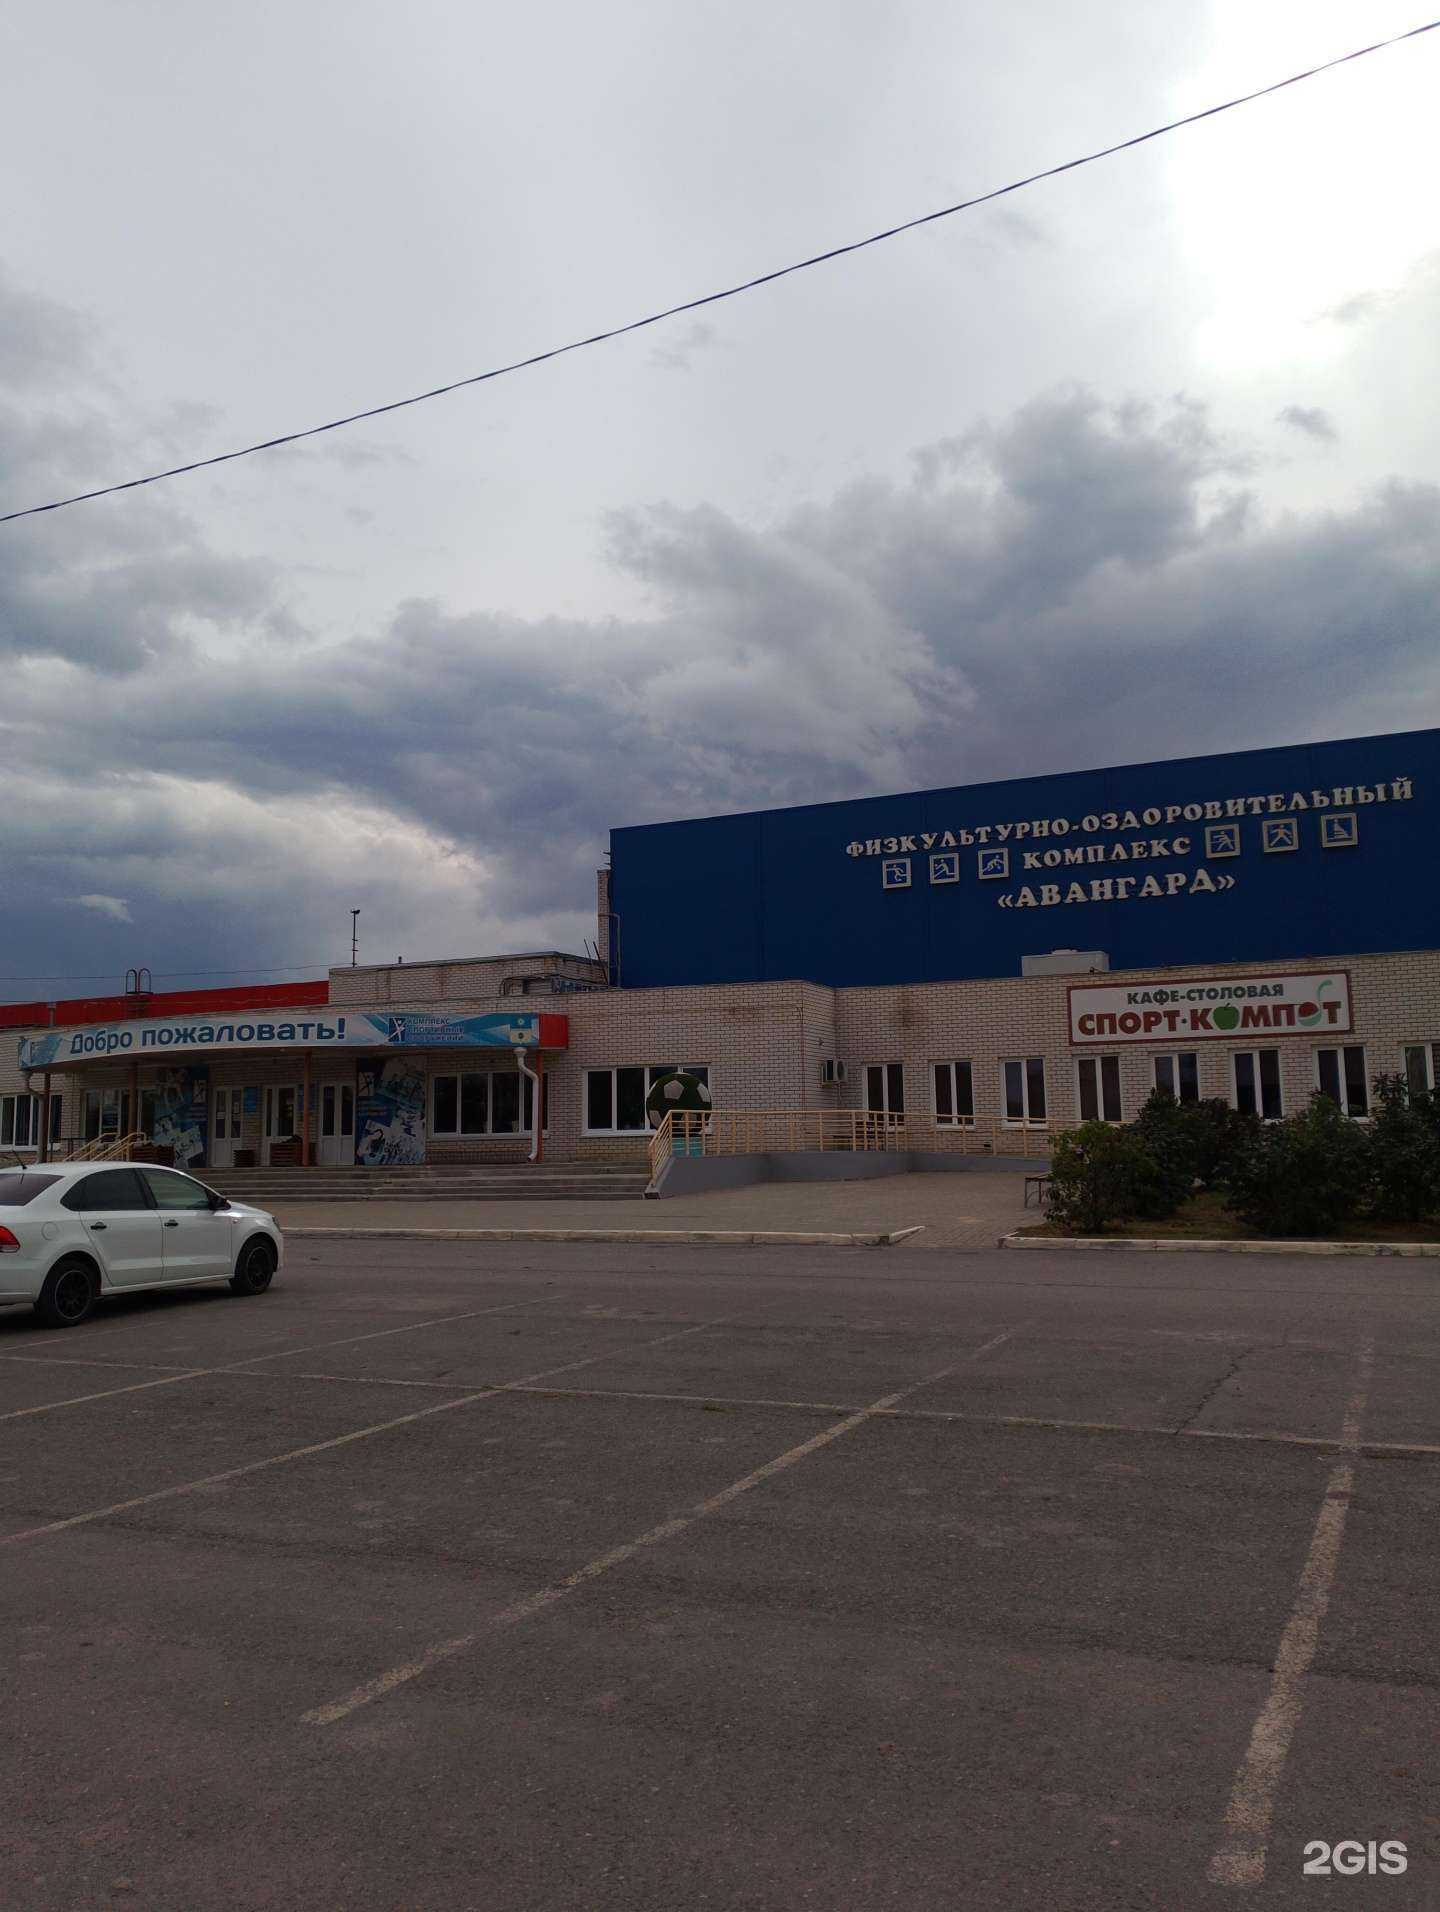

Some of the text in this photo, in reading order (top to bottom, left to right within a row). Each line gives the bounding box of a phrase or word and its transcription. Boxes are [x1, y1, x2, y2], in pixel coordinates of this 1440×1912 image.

[846, 777, 1413, 857] ФИЗКУЛЬТУРНО-ОЗДОРОВИТЕЛЬНЫЙ
[1023, 837, 1191, 870] КОМПЛЕКС
[998, 868, 1236, 908] «АВАНГАРД»
[1127, 983, 1284, 1006] КАФЕ-СТОЛОВАЯ
[70, 1017, 346, 1054] Добро пожаловать!
